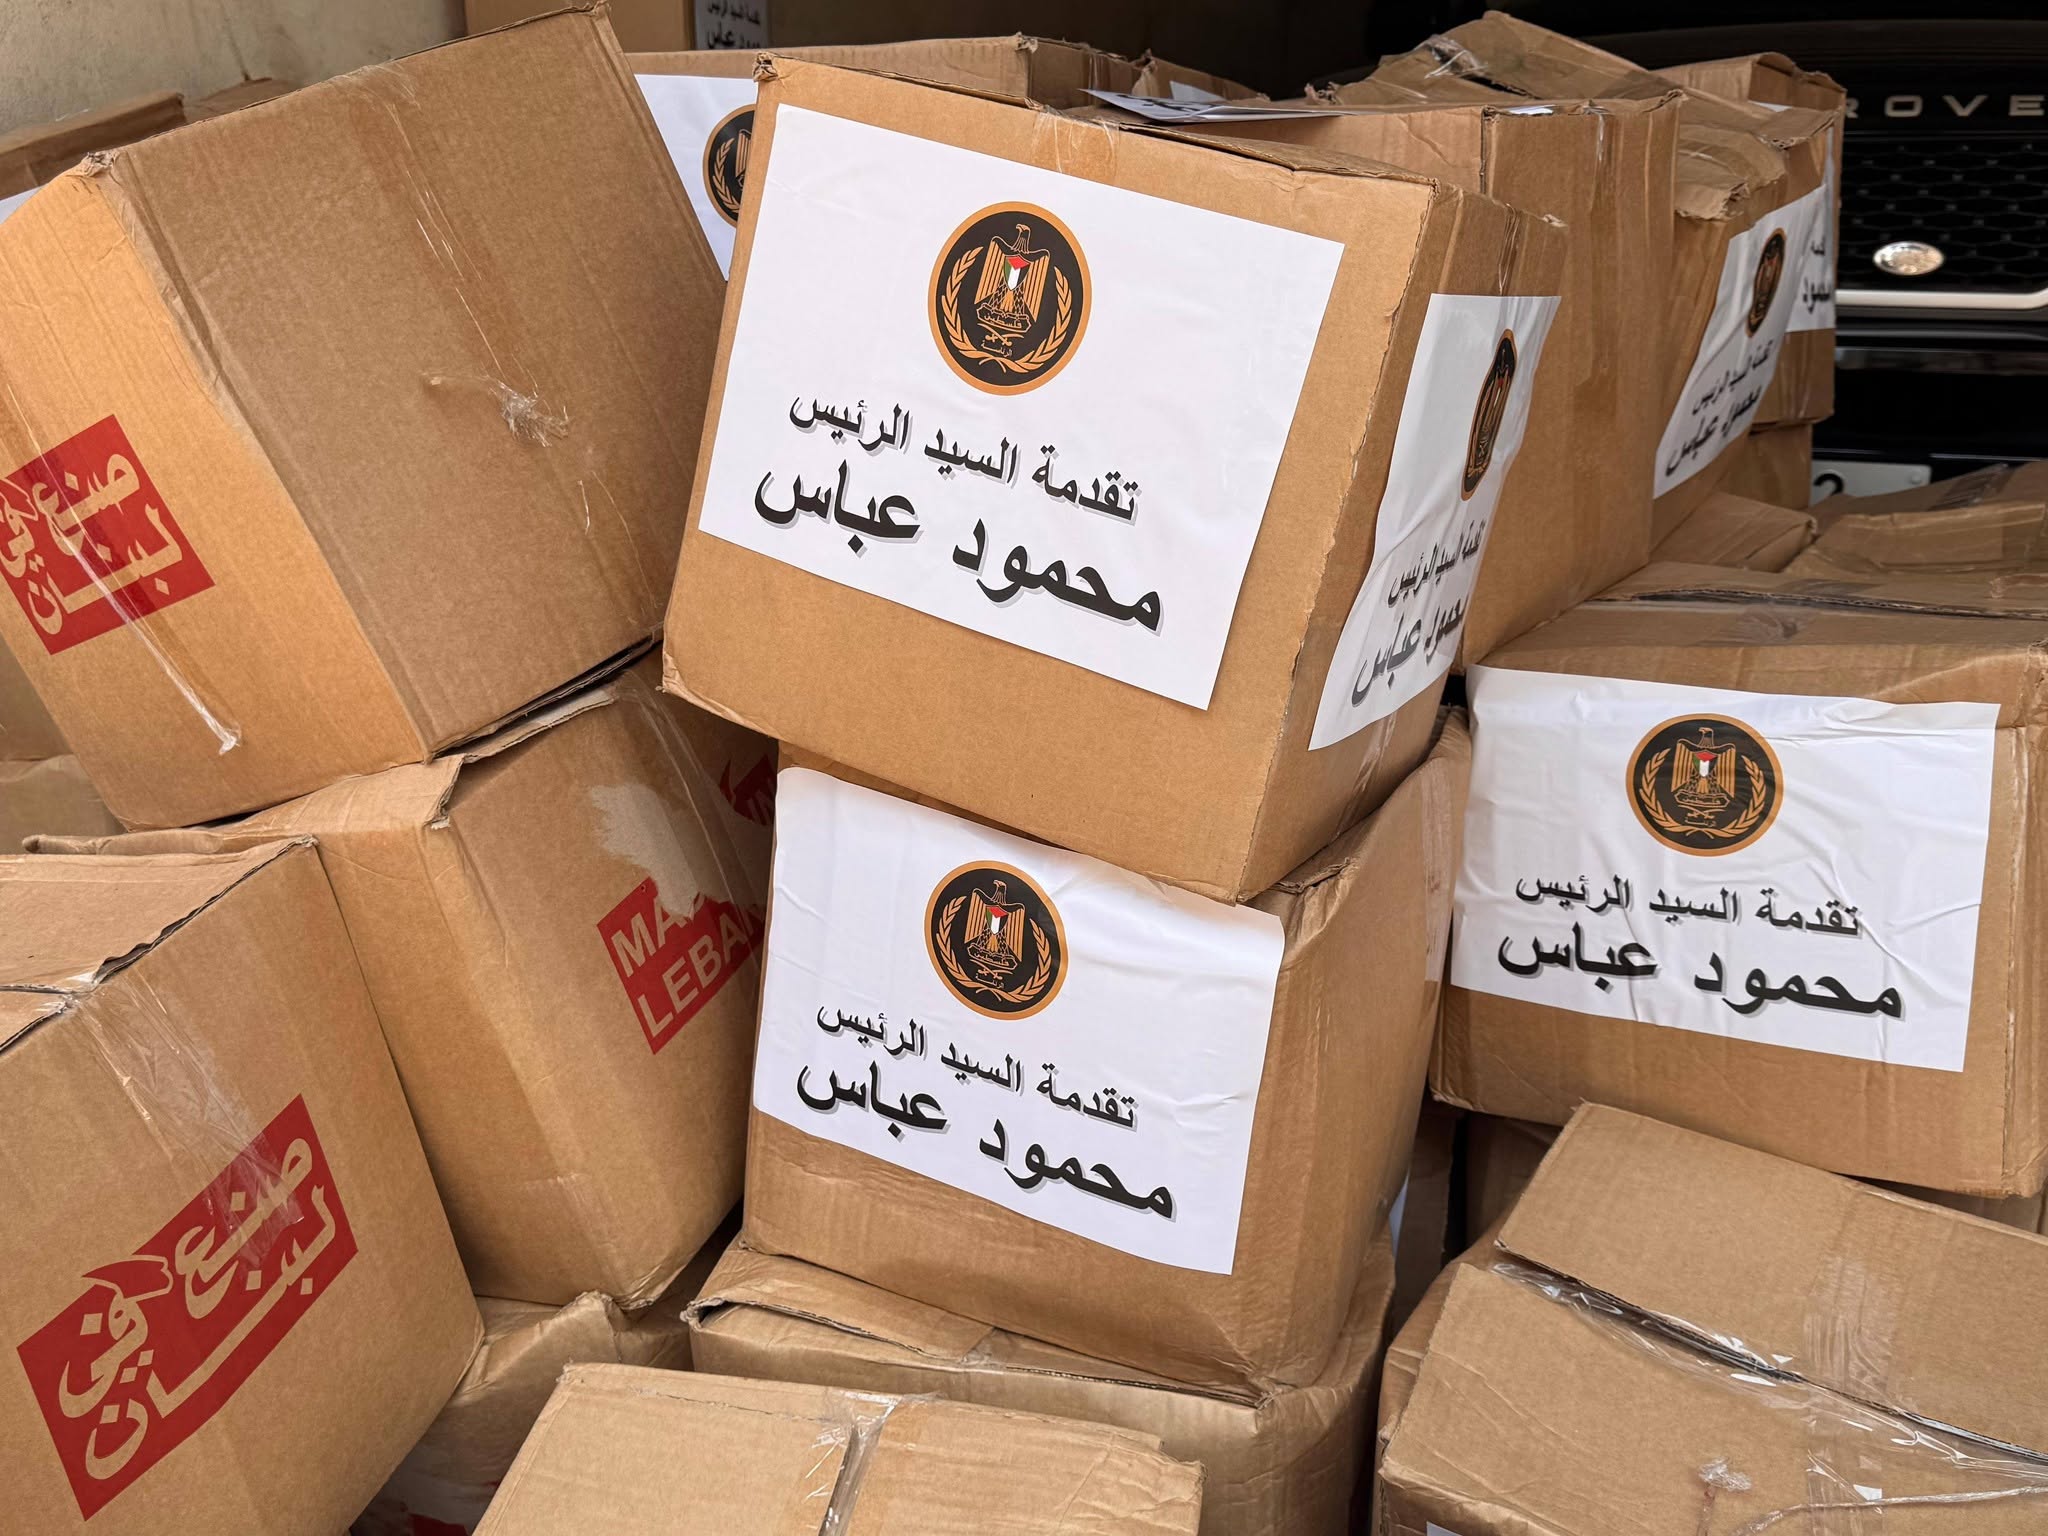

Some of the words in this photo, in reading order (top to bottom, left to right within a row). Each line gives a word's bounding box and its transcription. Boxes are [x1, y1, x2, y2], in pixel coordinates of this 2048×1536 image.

[983, 313, 1023, 330] فلسطين
[789, 396, 911, 452] الرئيس
[923, 428, 1018, 485] السيد
[754, 458, 921, 554] عباس
[1032, 444, 1140, 521] تقدمة
[27, 503, 183, 635] لبنان
[952, 517, 1162, 633] محمود
[1351, 611, 1422, 708] عباس
[1515, 874, 1632, 913] الرئيس
[1649, 886, 1739, 924] السيد
[1754, 886, 1860, 937] تقدمة
[1497, 921, 1660, 993] عباس
[1693, 951, 1902, 1019] محمود
[816, 1005, 926, 1057] الرئيس
[796, 1060, 949, 1139] عباس
[940, 1042, 1022, 1094] السيد
[1036, 1062, 1137, 1129] تقدمة
[978, 1117, 1175, 1219] محمود
[174, 1138, 313, 1320] صنع
[85, 1184, 336, 1480] لبنان
